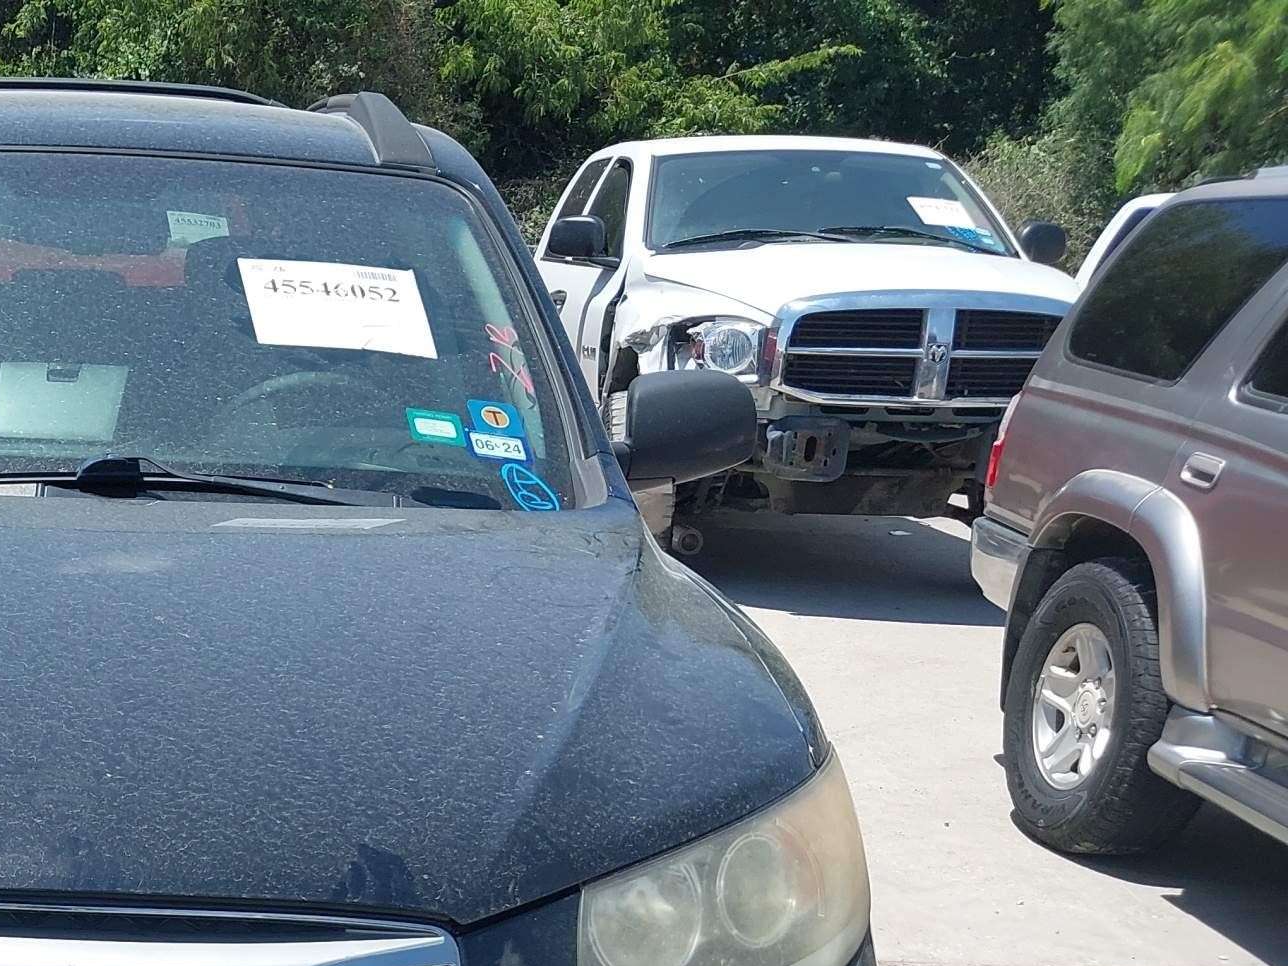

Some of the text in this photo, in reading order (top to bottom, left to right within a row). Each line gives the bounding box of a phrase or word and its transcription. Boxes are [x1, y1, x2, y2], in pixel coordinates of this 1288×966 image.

[263, 278, 401, 303] 45546052
[475, 438, 522, 455] 06 24
